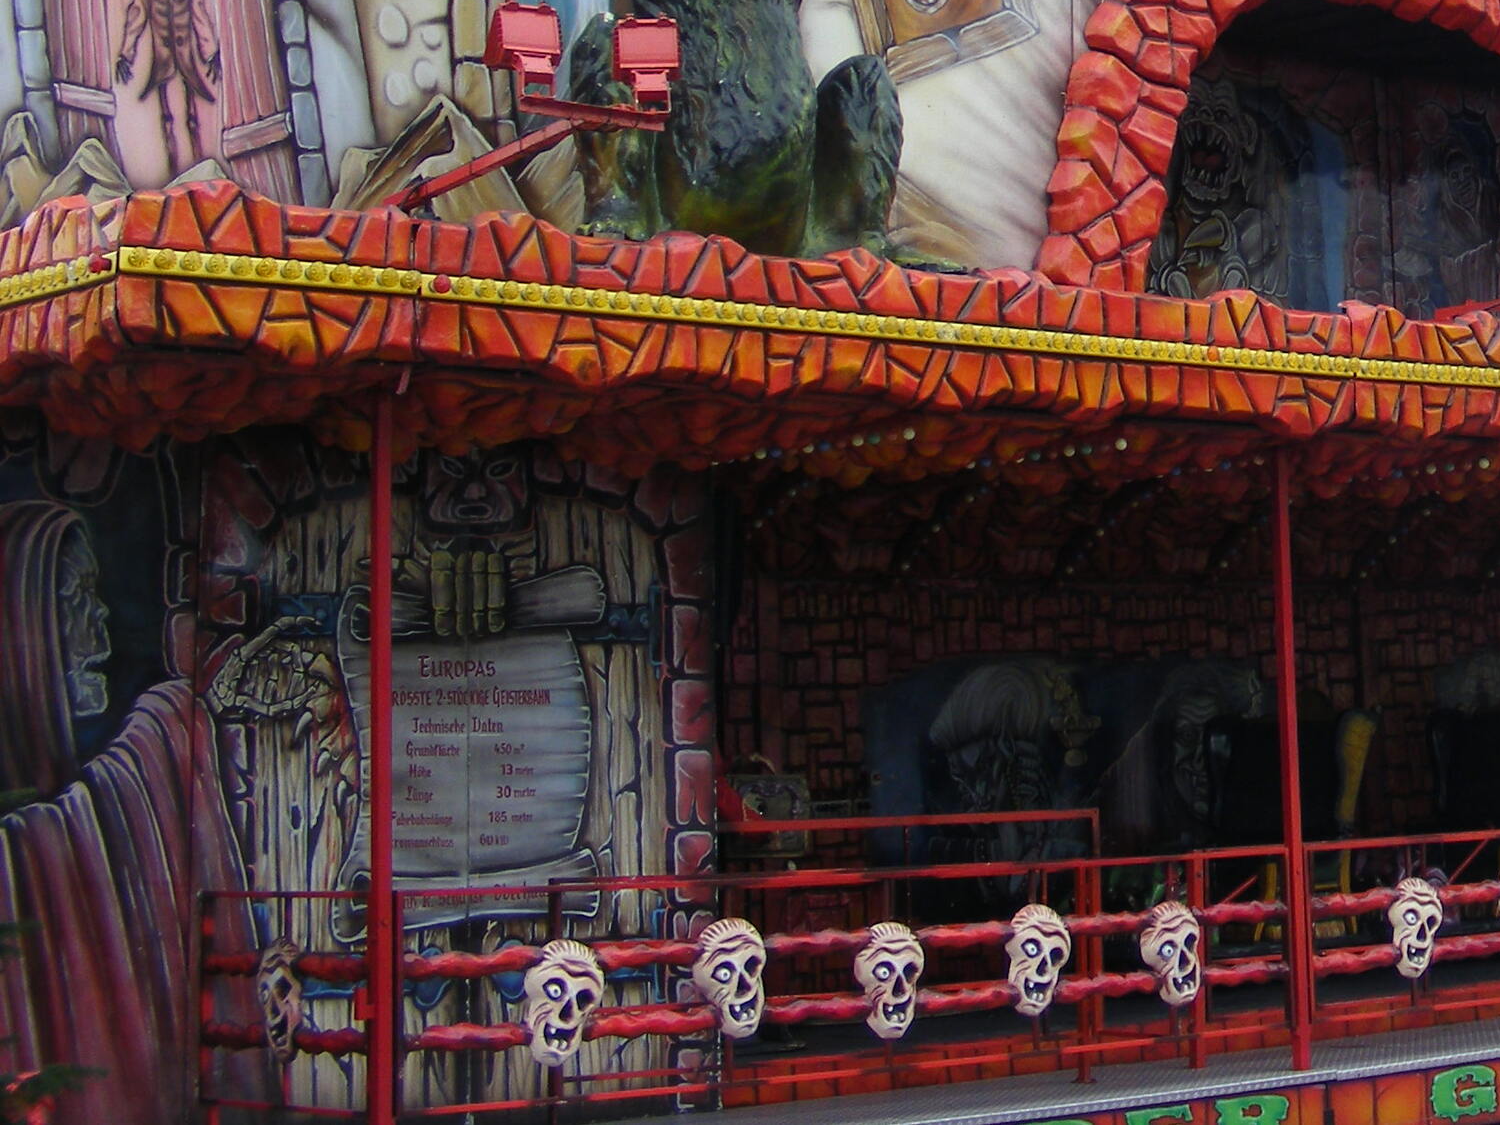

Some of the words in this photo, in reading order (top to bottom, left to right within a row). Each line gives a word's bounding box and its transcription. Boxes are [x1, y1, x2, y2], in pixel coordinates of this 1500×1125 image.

[418, 654, 497, 679] EUROPAS
[501, 763, 514, 776] 13
[496, 786, 512, 799] 30
[488, 811, 508, 823] 185
